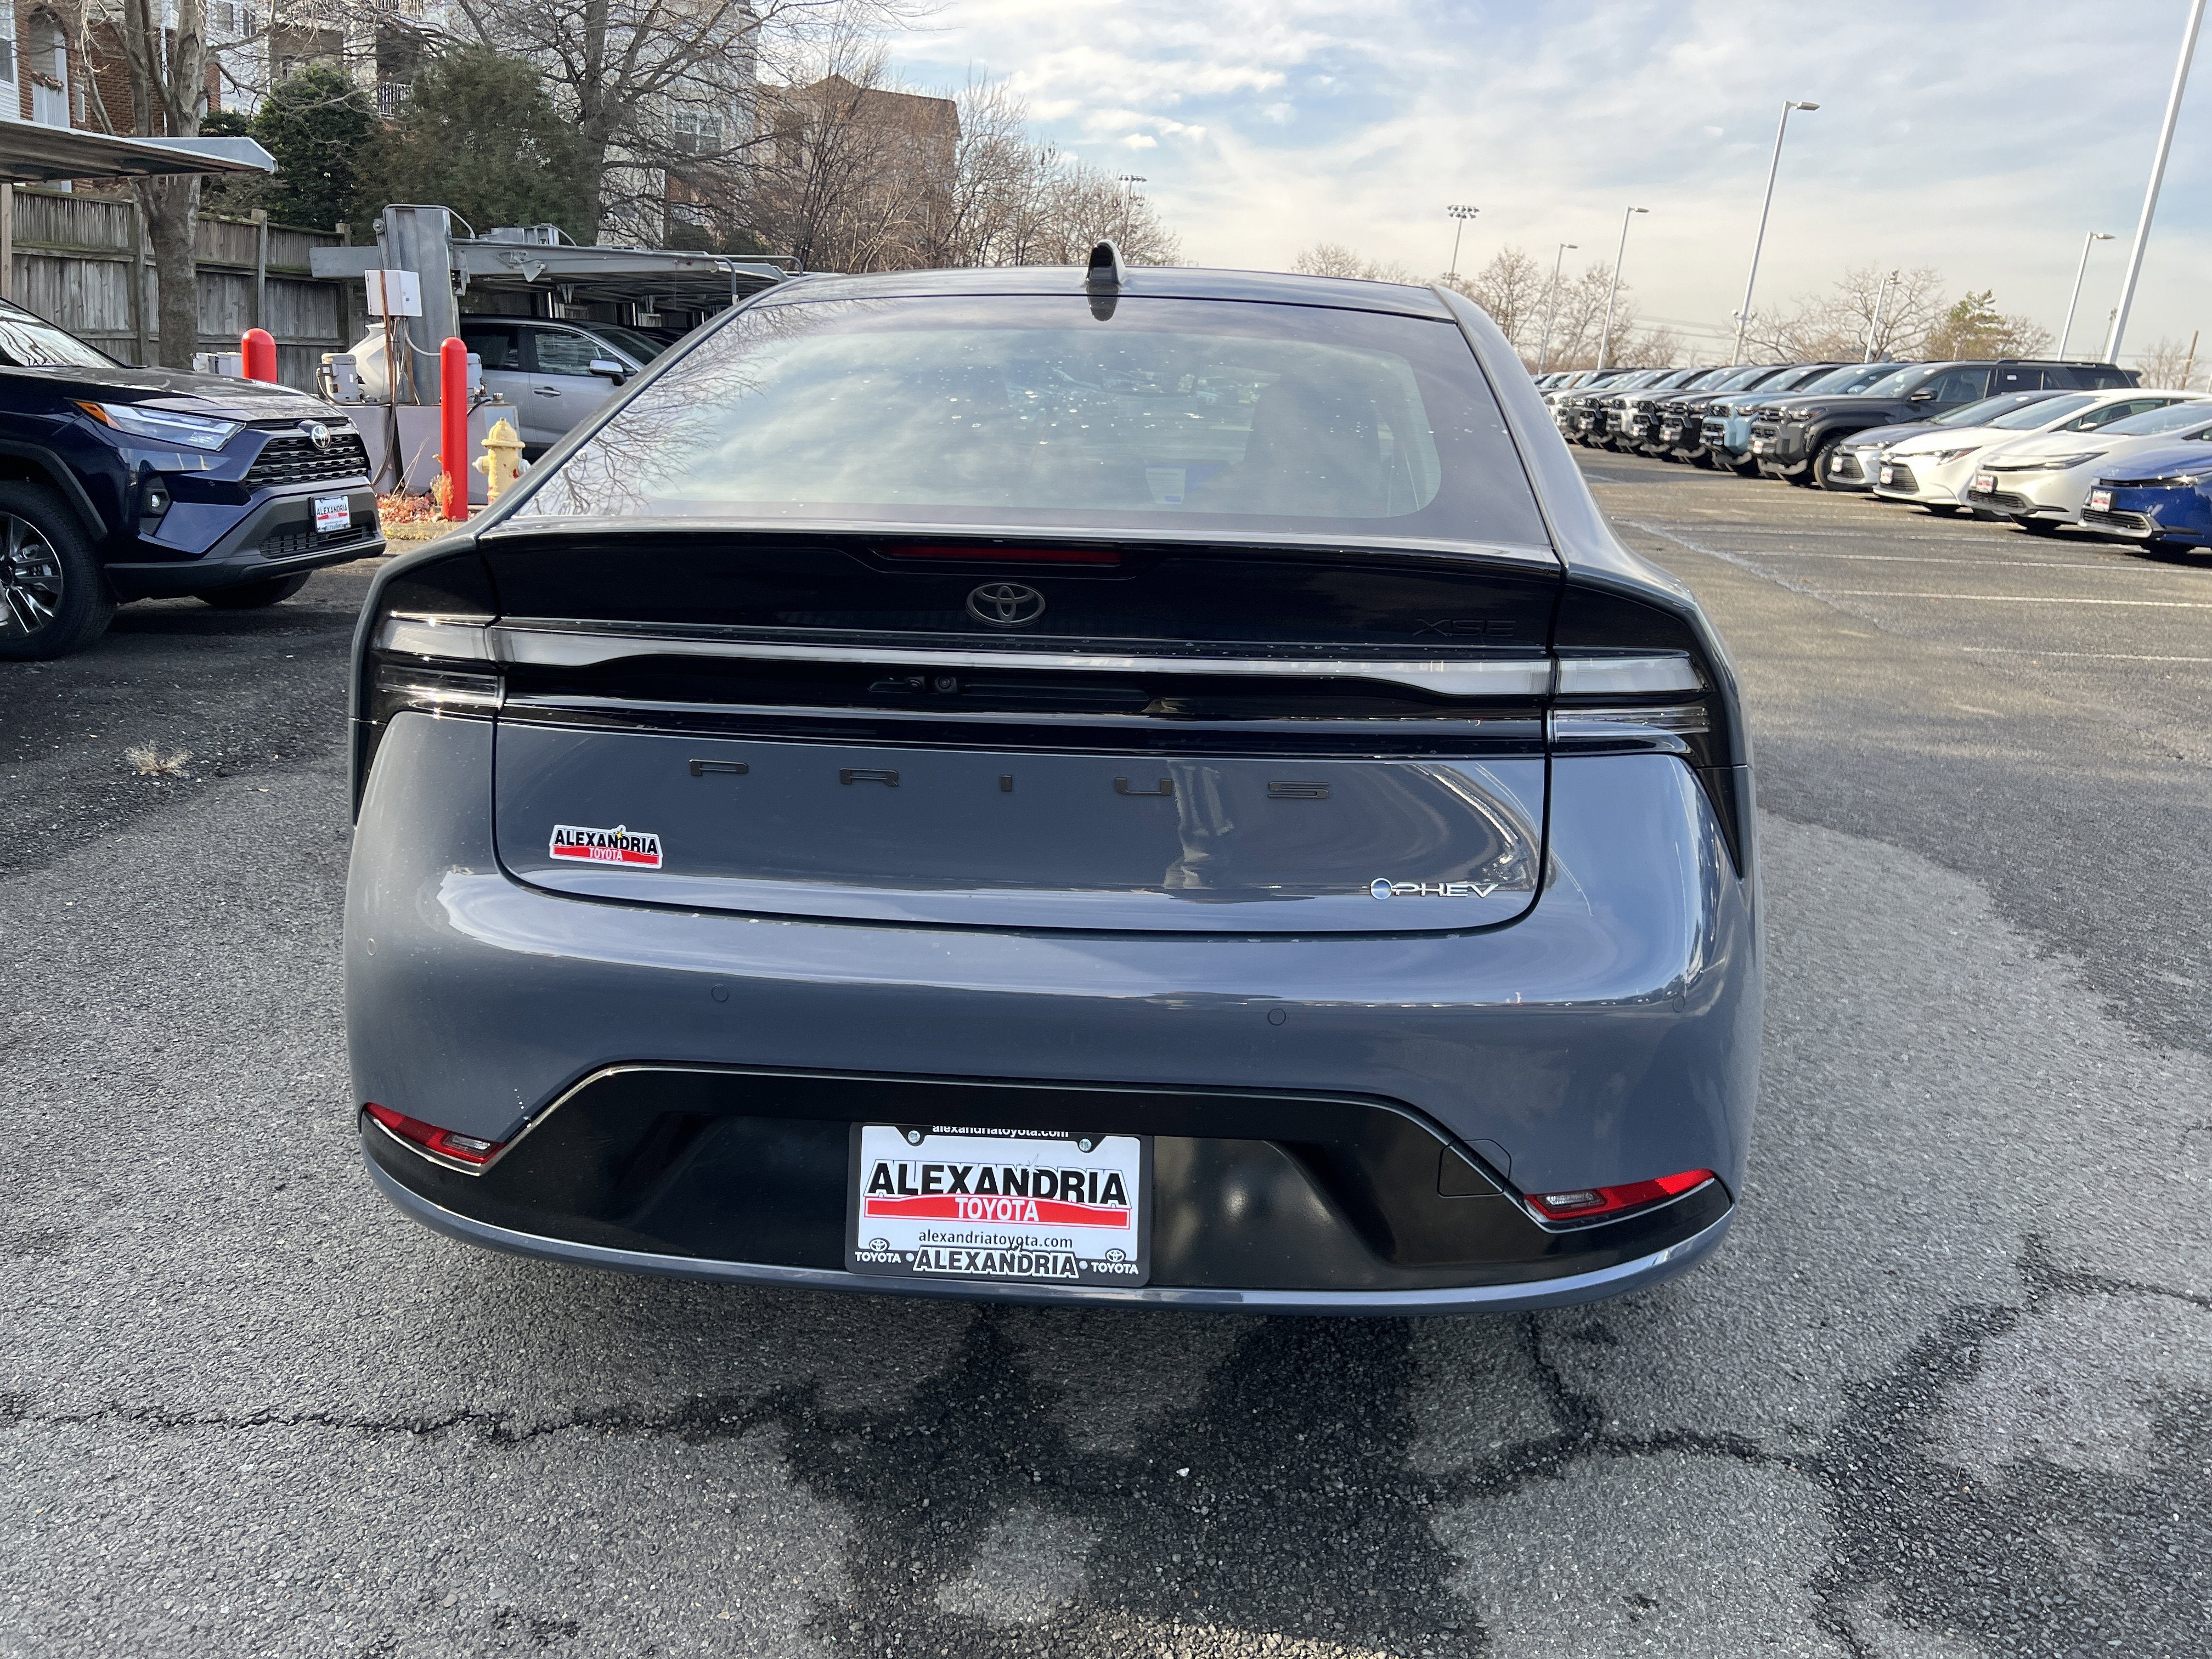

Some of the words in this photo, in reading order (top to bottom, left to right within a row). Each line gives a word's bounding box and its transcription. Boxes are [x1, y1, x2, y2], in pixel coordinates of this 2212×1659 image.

[1413, 619, 1516, 637] XSE
[689, 759, 1330, 799] PRIUS
[554, 829, 658, 854] ALEXANDRIA
[589, 847, 624, 861] TOYOTA
[1393, 881, 1499, 898] PHEV
[867, 1161, 1128, 1207] ALEXANDRIA
[955, 1197, 1040, 1222] TOYOTA
[918, 1229, 1073, 1249] alexandriatoyota.com
[854, 1251, 902, 1263] TOYOTA
[913, 1246, 1080, 1279] ALEXANDRIA
[1091, 1262, 1139, 1275] TOYOTA
